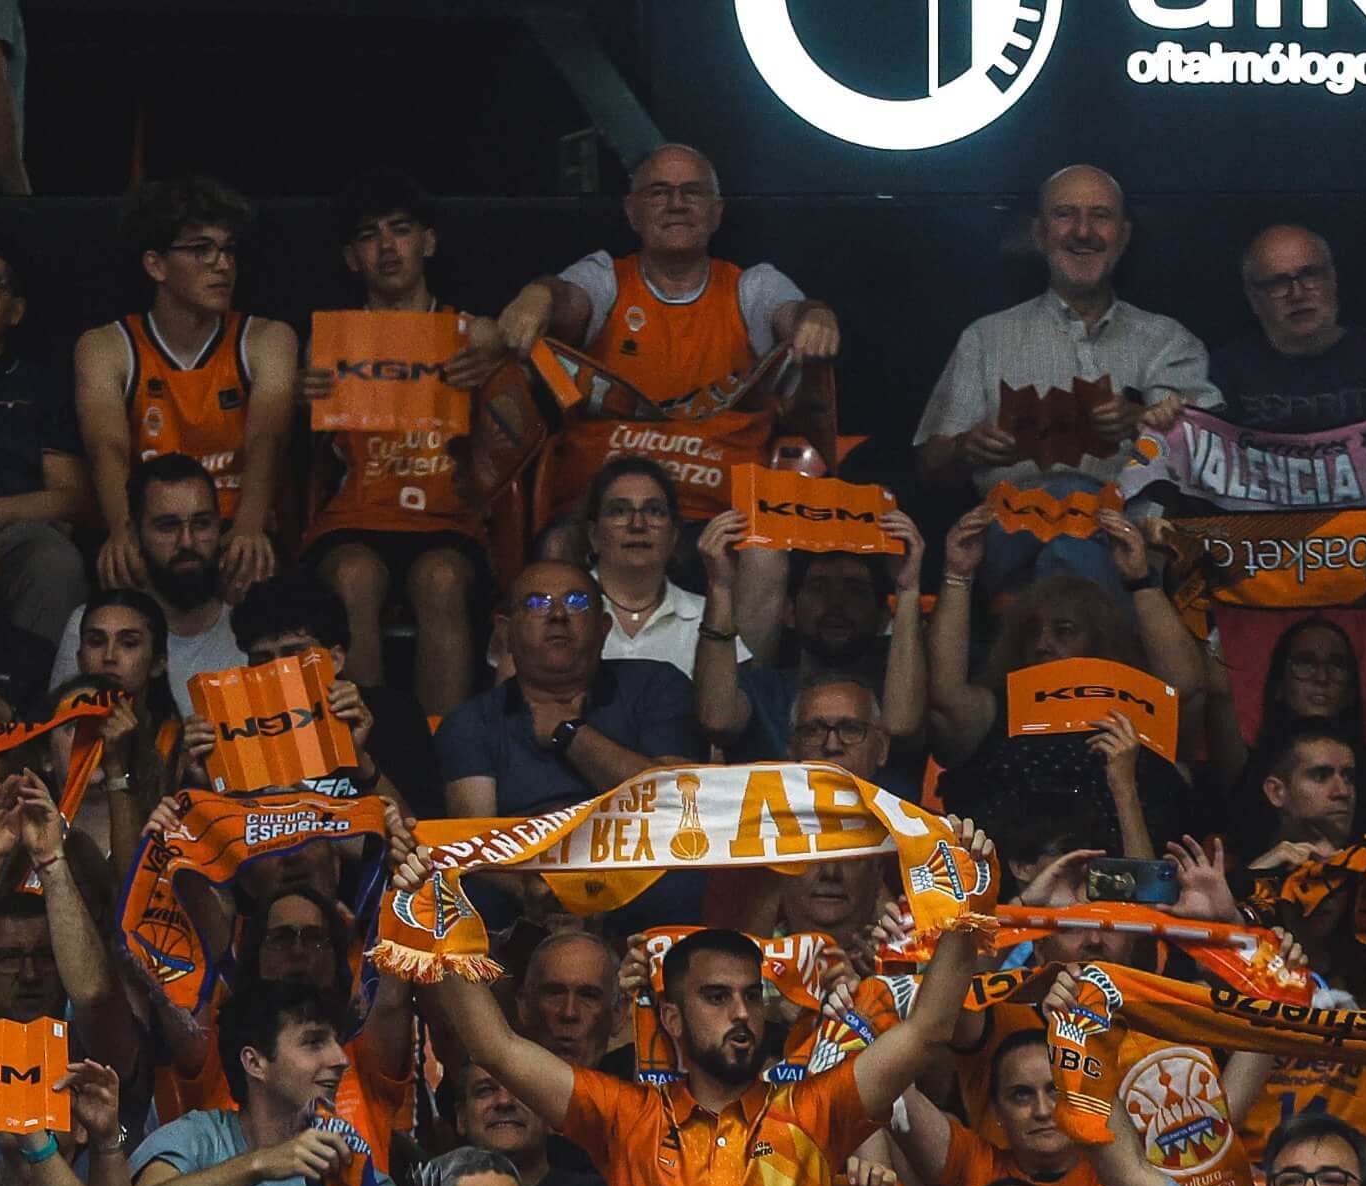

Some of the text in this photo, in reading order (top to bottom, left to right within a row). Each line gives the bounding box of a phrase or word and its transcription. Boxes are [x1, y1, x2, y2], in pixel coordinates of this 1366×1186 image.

[337, 361, 447, 380] KGM
[609, 425, 704, 457] Cultura
[1184, 421, 1354, 505] VALENCIA
[757, 500, 875, 521] KGM
[1033, 684, 1155, 716] KGM
[219, 701, 324, 741] KGM
